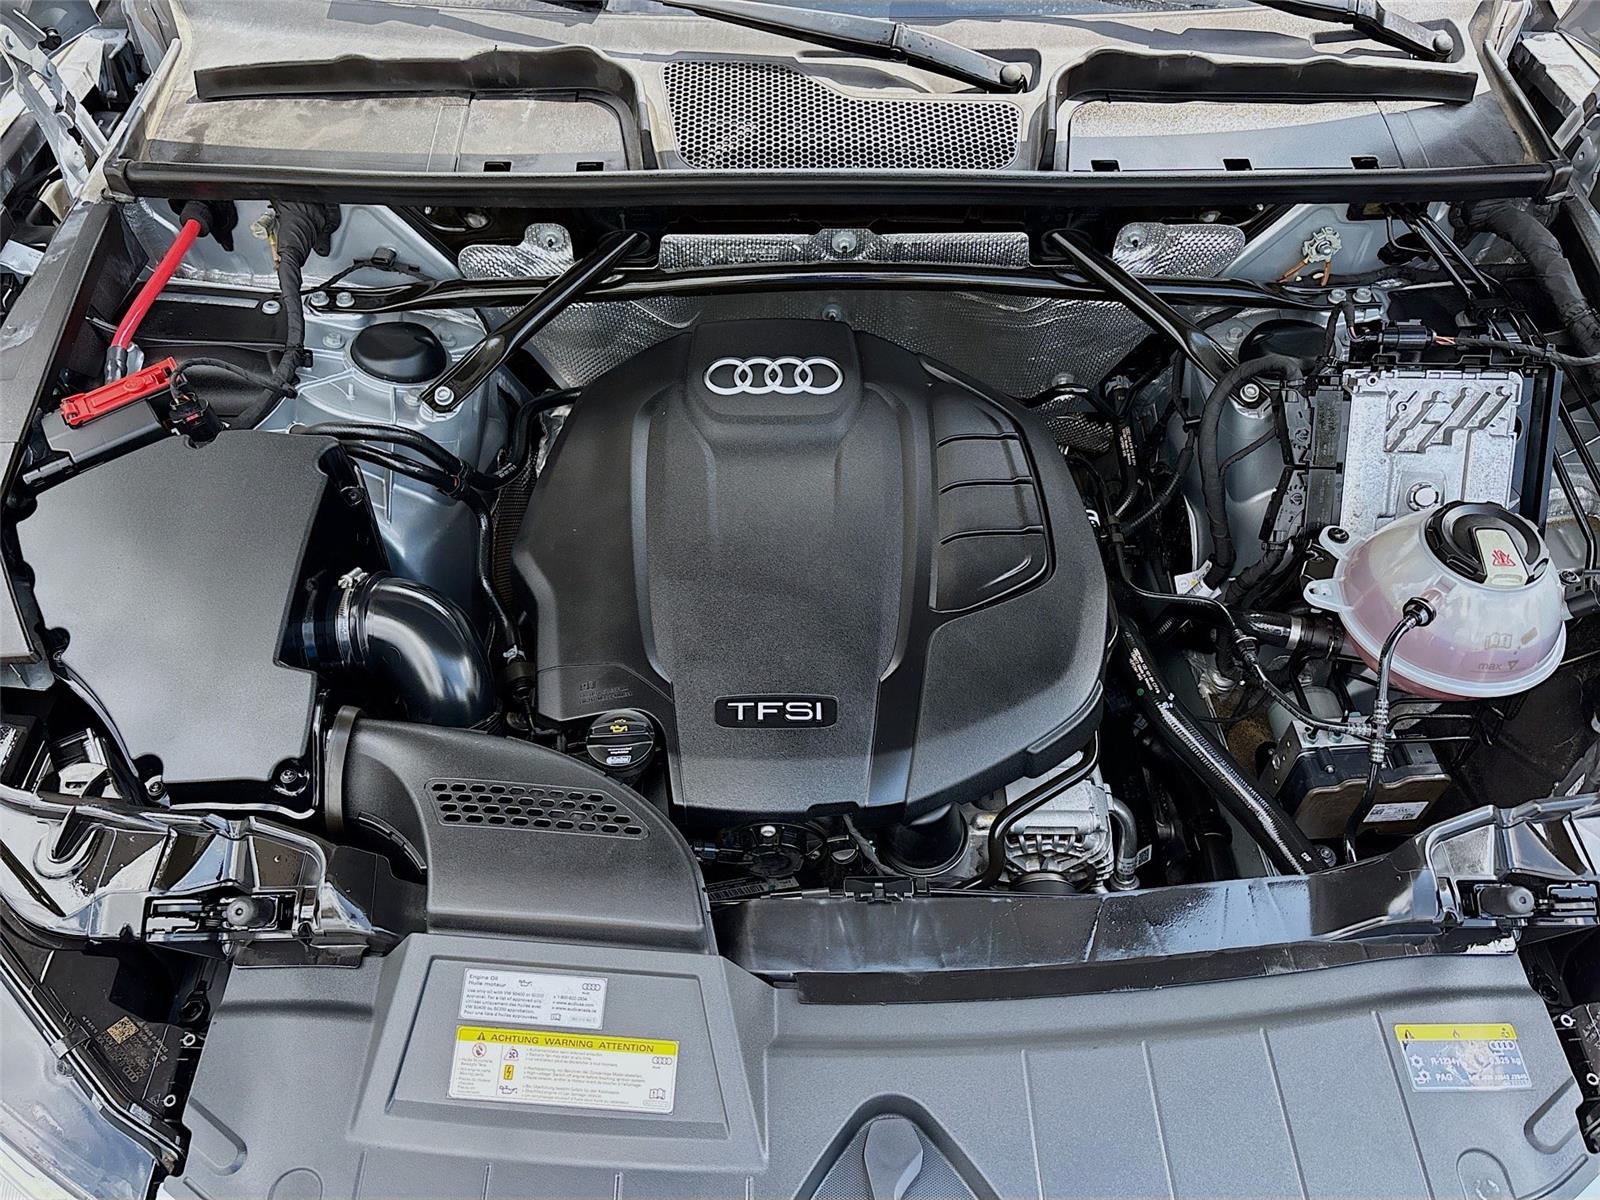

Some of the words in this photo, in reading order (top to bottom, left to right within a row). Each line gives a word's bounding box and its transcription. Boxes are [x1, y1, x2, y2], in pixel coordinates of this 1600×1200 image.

[1478, 662, 1502, 671] max
[728, 702, 822, 721] TFSI
[491, 1034, 539, 1045] ACHTUNG
[545, 1037, 593, 1048] WARNING
[599, 1041, 654, 1052] ATTENTION
[1436, 1073, 1453, 1081] PAG
